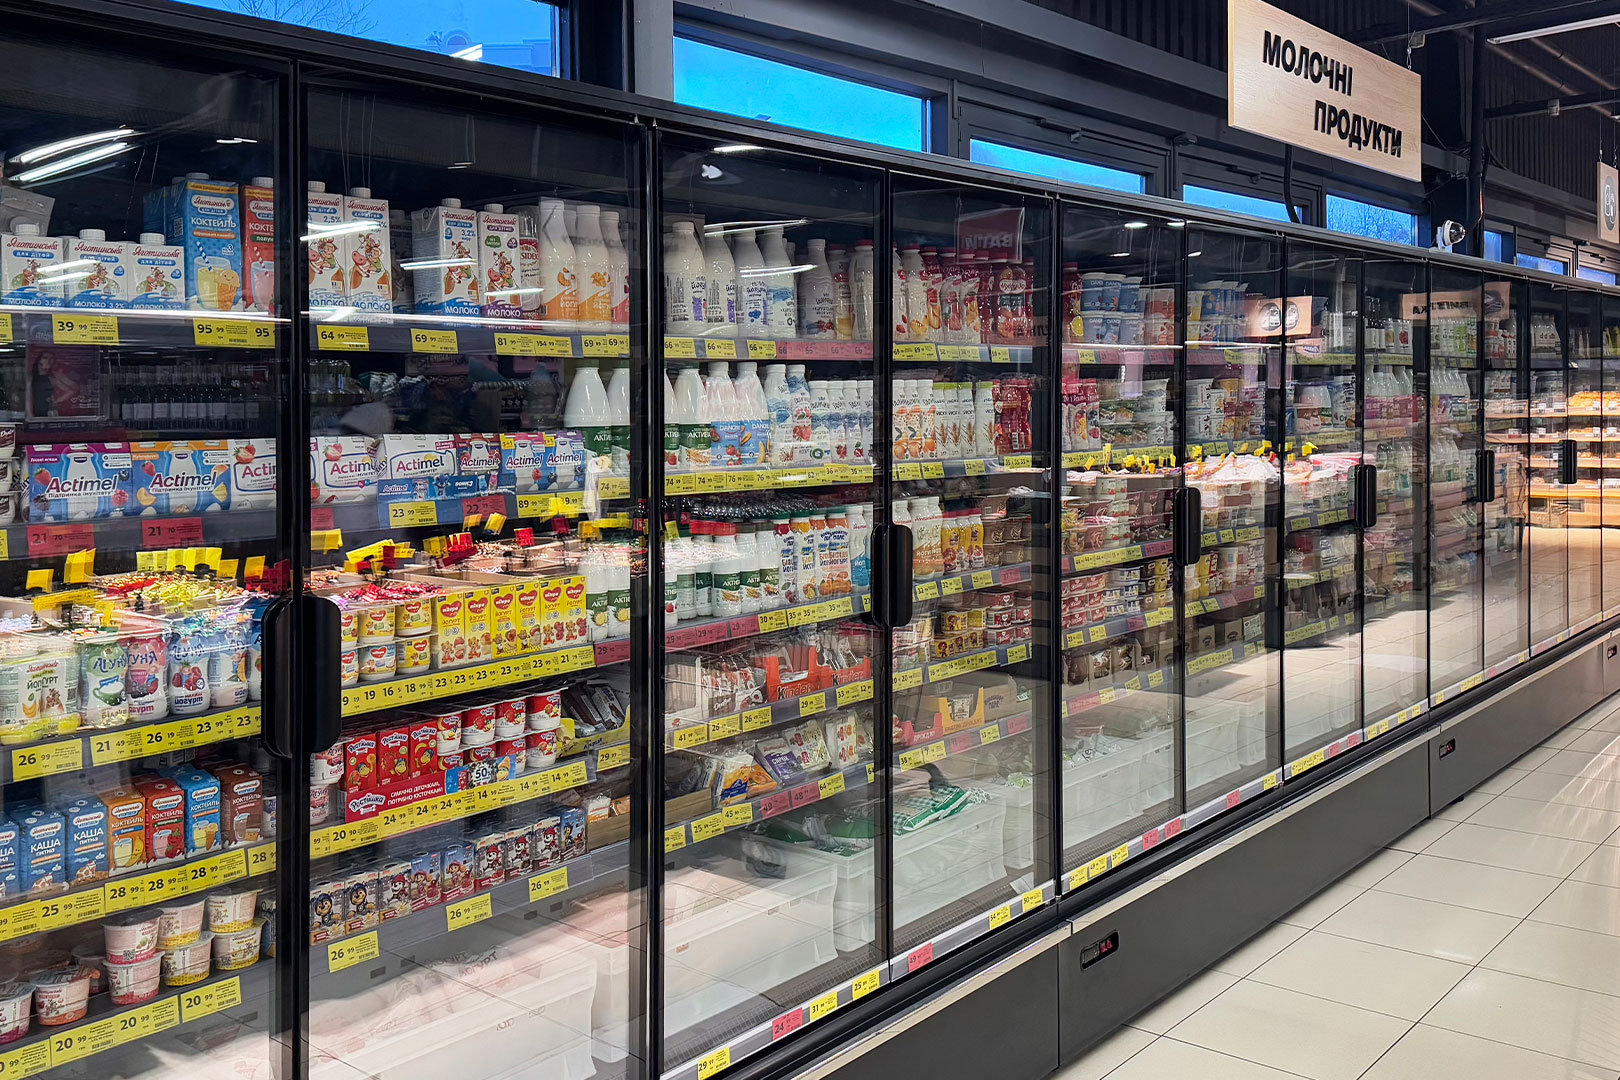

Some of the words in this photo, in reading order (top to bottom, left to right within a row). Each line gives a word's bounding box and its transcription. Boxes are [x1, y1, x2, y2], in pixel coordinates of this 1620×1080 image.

[1262, 30, 1353, 96] МОЛОЧНІ
[1314, 100, 1403, 158] ПРОДУКТИ
[191, 217, 236, 228] КОКТЕЙЛЬ
[8, 298, 42, 306] МОЛОКО
[352, 302, 391, 312] МОЛОКО
[445, 304, 480, 316] МОЛОКО
[488, 308, 521, 318] МОЛОКО
[57, 322, 74, 332] 39
[197, 324, 212, 334] 95
[255, 328, 270, 338] 95
[320, 330, 335, 340] 64
[414, 334, 428, 343] 69
[498, 337, 507, 346] 81
[608, 338, 618, 346] 69
[584, 340, 594, 348] 69
[664, 341, 674, 349] 66
[707, 342, 716, 350] 66
[506, 454, 543, 468] Actimel
[547, 452, 582, 464] Actimel
[396, 456, 444, 472] Actimel
[46, 474, 119, 494] Actimel
[150, 472, 216, 488] Actimel
[666, 478, 674, 486] 74
[698, 476, 706, 485] 74
[728, 475, 736, 483] 76
[600, 482, 610, 491] 74
[518, 499, 529, 508] 89
[392, 508, 405, 518] 23
[466, 504, 478, 514] 22
[148, 526, 162, 537] 21
[32, 534, 47, 544] 21
[788, 612, 797, 620] 35
[802, 608, 811, 617] 35
[760, 616, 768, 624] 30
[597, 646, 608, 655] 29
[560, 654, 570, 664] 21
[532, 660, 543, 669] 23
[476, 670, 488, 680] 23
[500, 666, 512, 676] 23
[435, 678, 448, 688] 23
[454, 674, 466, 684] 23
[382, 686, 394, 697] 16
[404, 684, 416, 693] 18
[778, 682, 811, 700] Kinder
[364, 690, 376, 701] 19
[800, 700, 808, 709] 29
[237, 716, 252, 727] 23
[744, 714, 752, 723] 26
[196, 722, 212, 734] 23
[215, 720, 224, 728] 99
[146, 732, 163, 744] 26
[678, 734, 687, 743] 41
[96, 740, 110, 753] 21
[18, 752, 37, 766] 26
[41, 753, 50, 761] 99
[600, 753, 610, 762] 29
[552, 773, 561, 782] 14
[520, 781, 530, 790] 14
[820, 783, 827, 791] 64
[390, 788, 413, 798] СМАЧНО
[478, 790, 488, 800] 14
[232, 794, 261, 804] КОКТЕЙЛЬ
[190, 800, 220, 812] КОКТЕЙЛЬ
[440, 800, 453, 810] 24
[764, 802, 773, 812] 49
[152, 808, 184, 820] КОКТЕЙЛЬ
[416, 805, 429, 816] 24
[724, 810, 734, 818] 45
[111, 816, 144, 829] КОКТЕЙЛЬ
[384, 814, 396, 826] 24
[74, 828, 104, 840] КАША
[694, 824, 703, 834] 25
[332, 830, 346, 842] 20
[30, 838, 61, 853] КАША
[252, 852, 267, 864] 28
[191, 868, 207, 880] 28
[148, 878, 164, 892] 28
[531, 881, 542, 891] 26
[110, 886, 126, 900] 28
[130, 886, 139, 894] 99
[42, 904, 59, 918] 25
[450, 910, 462, 920] 26
[330, 949, 345, 961] 26
[854, 982, 862, 991] 25
[186, 996, 202, 1009] 20
[812, 1004, 820, 1014] 31
[120, 1016, 137, 1031] 20
[140, 1014, 150, 1022] 99
[774, 1023, 784, 1034] 24
[55, 1038, 73, 1052] 20
[77, 1036, 87, 1044] 99
[9, 1058, 20, 1068] 99
[698, 1062, 708, 1072] 29
